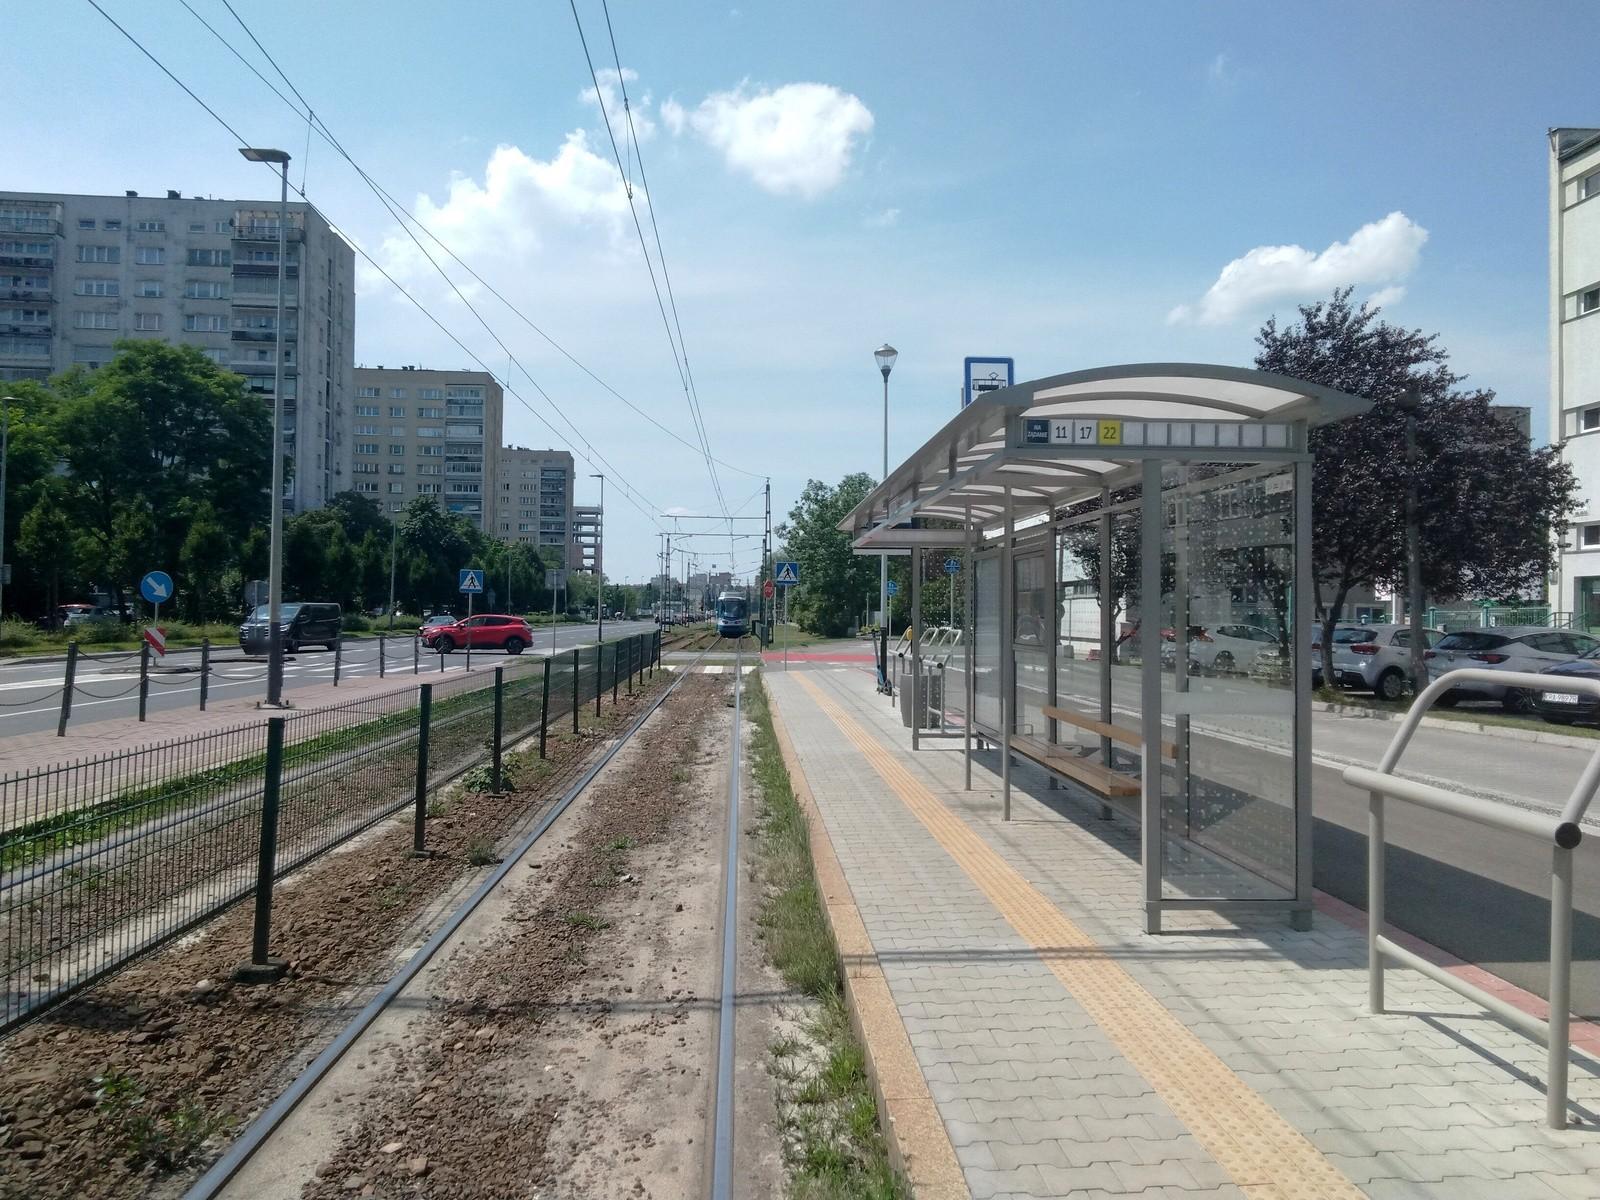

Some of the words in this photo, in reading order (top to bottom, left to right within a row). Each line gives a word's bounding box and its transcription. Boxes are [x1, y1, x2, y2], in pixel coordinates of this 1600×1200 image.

[1055, 426, 1067, 438] 11
[1079, 426, 1092, 439] 17
[1103, 426, 1116, 439] 22
